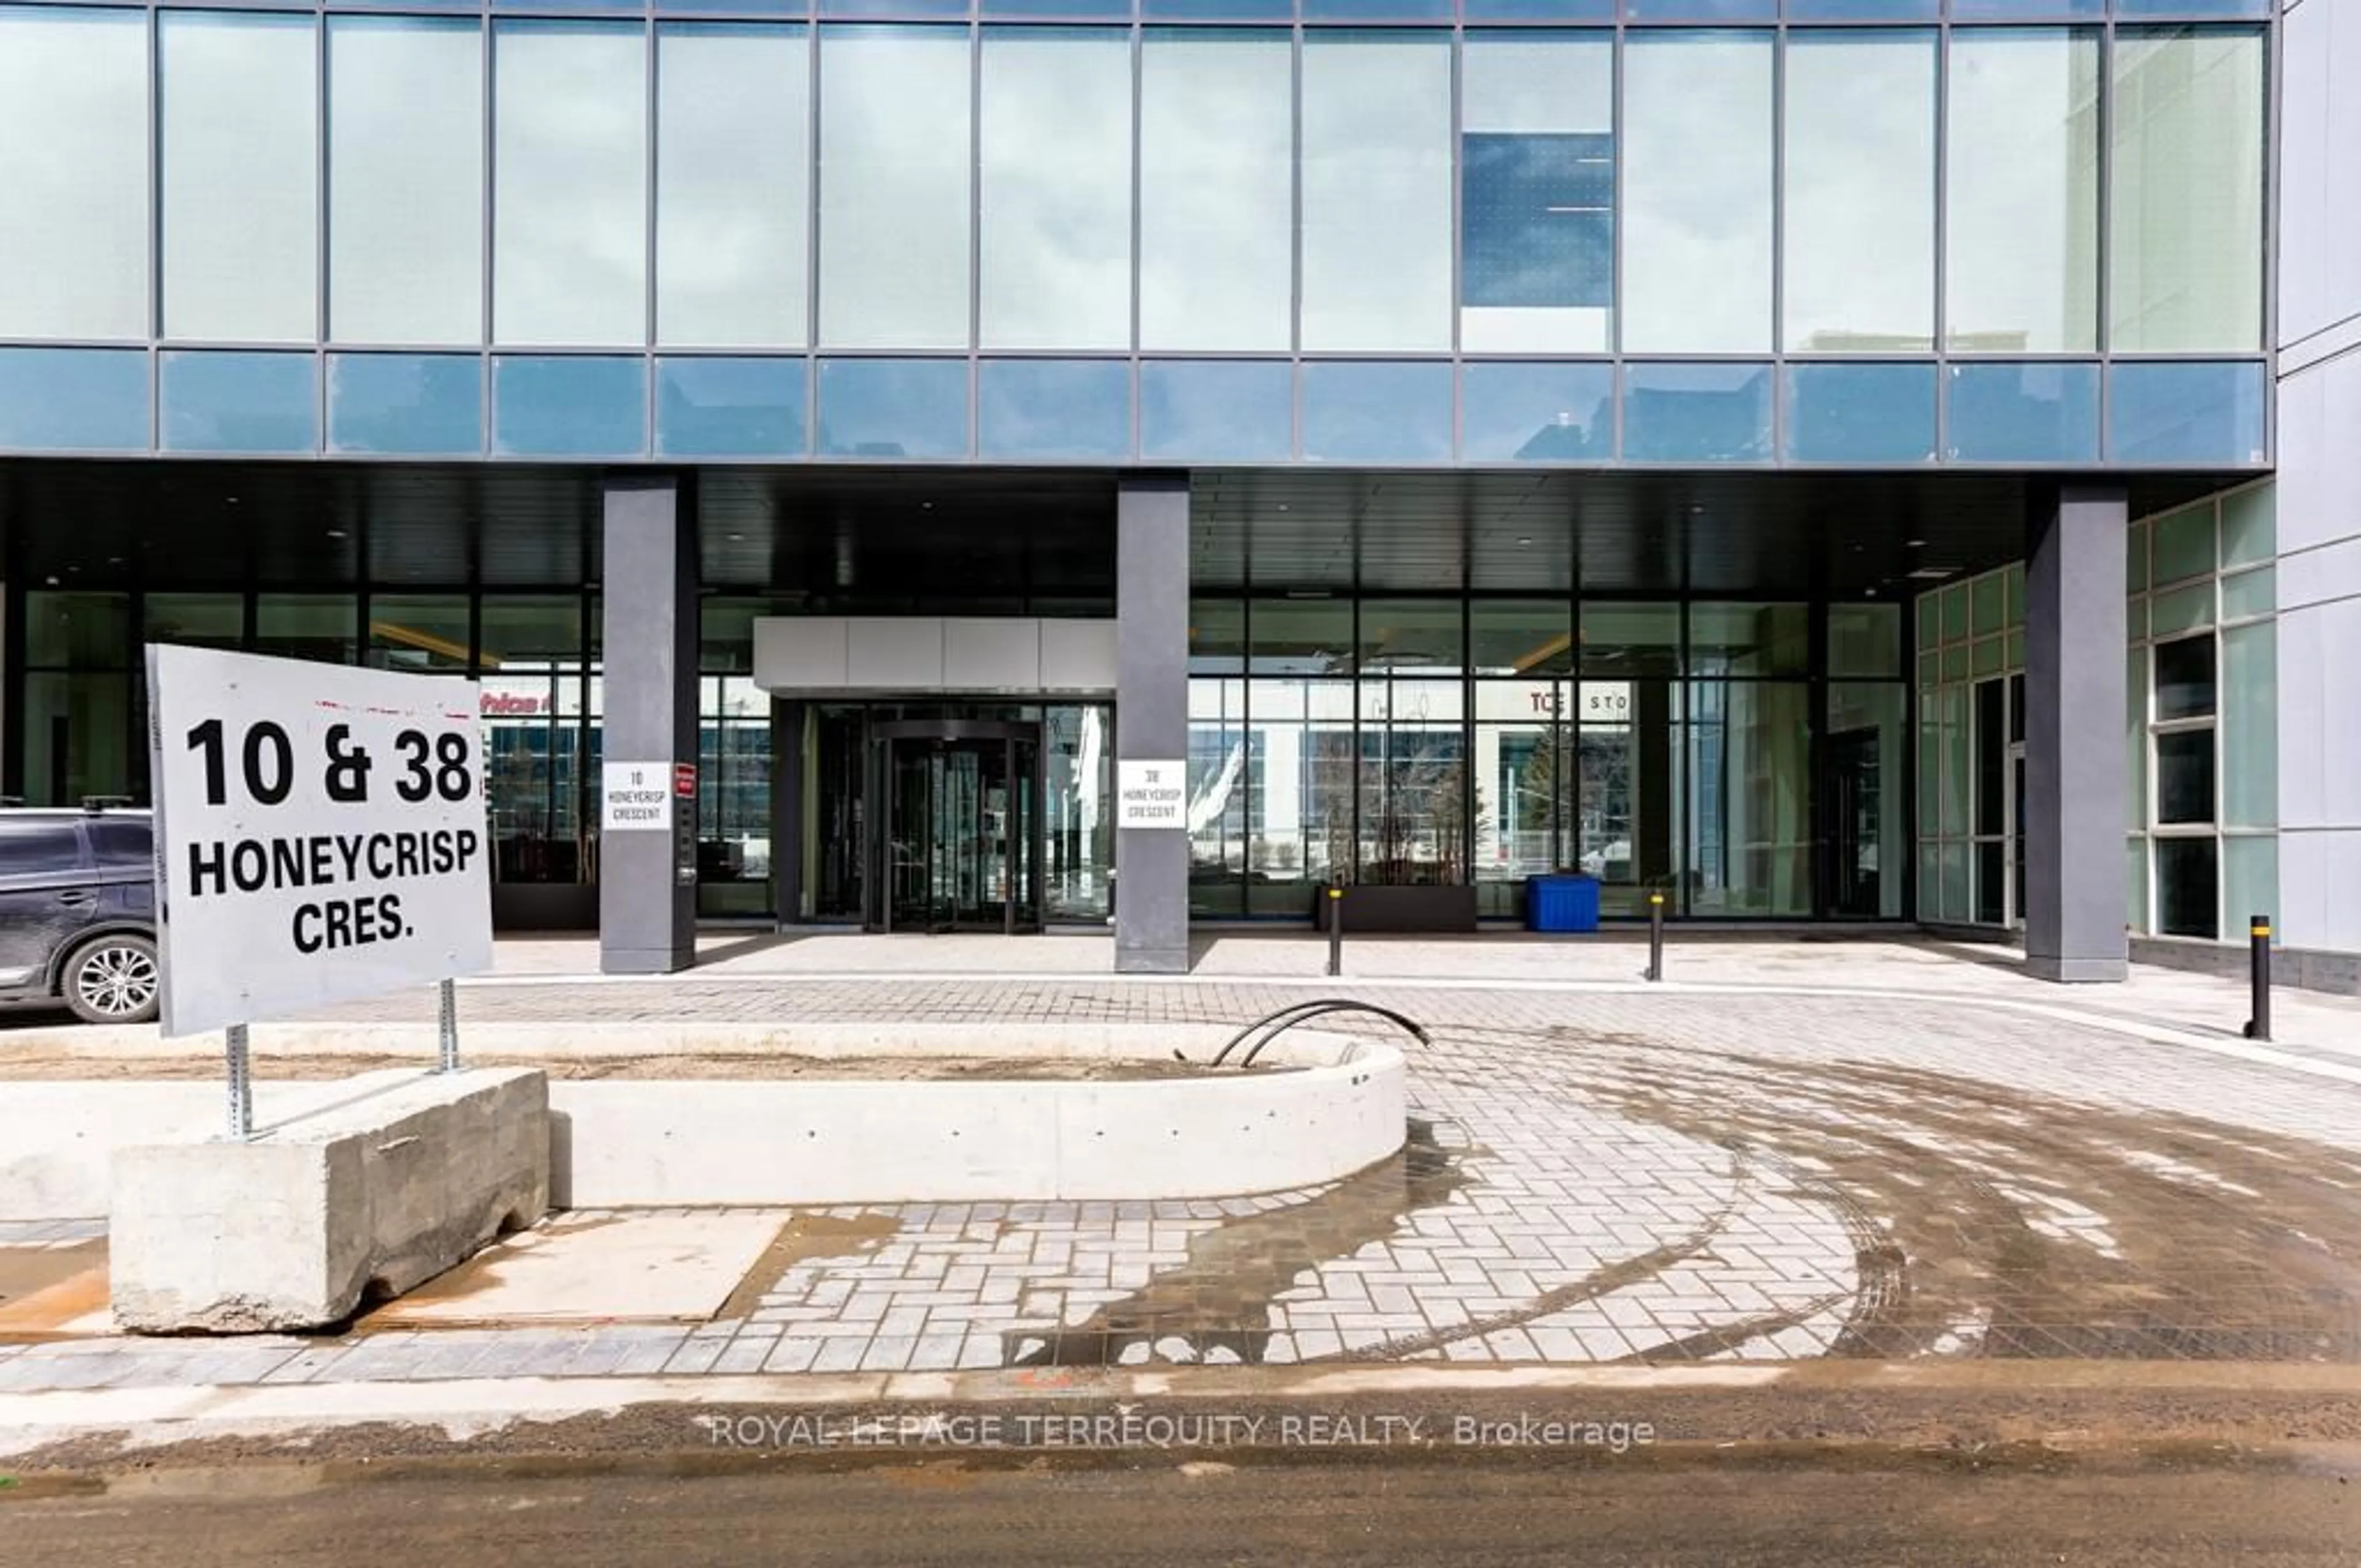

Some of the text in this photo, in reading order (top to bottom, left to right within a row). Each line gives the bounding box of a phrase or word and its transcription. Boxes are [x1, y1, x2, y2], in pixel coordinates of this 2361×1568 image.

[188, 719, 470, 805] 10 & 38
[631, 771, 643, 785] 10
[608, 791, 665, 803] HONEYCRISP
[1123, 789, 1181, 801] HONEYCRISP
[613, 808, 660, 820] CRESCENT
[1128, 806, 1176, 818] CRESCENT
[189, 830, 477, 895] HONEYCRISP
[293, 895, 413, 953] CRES.
